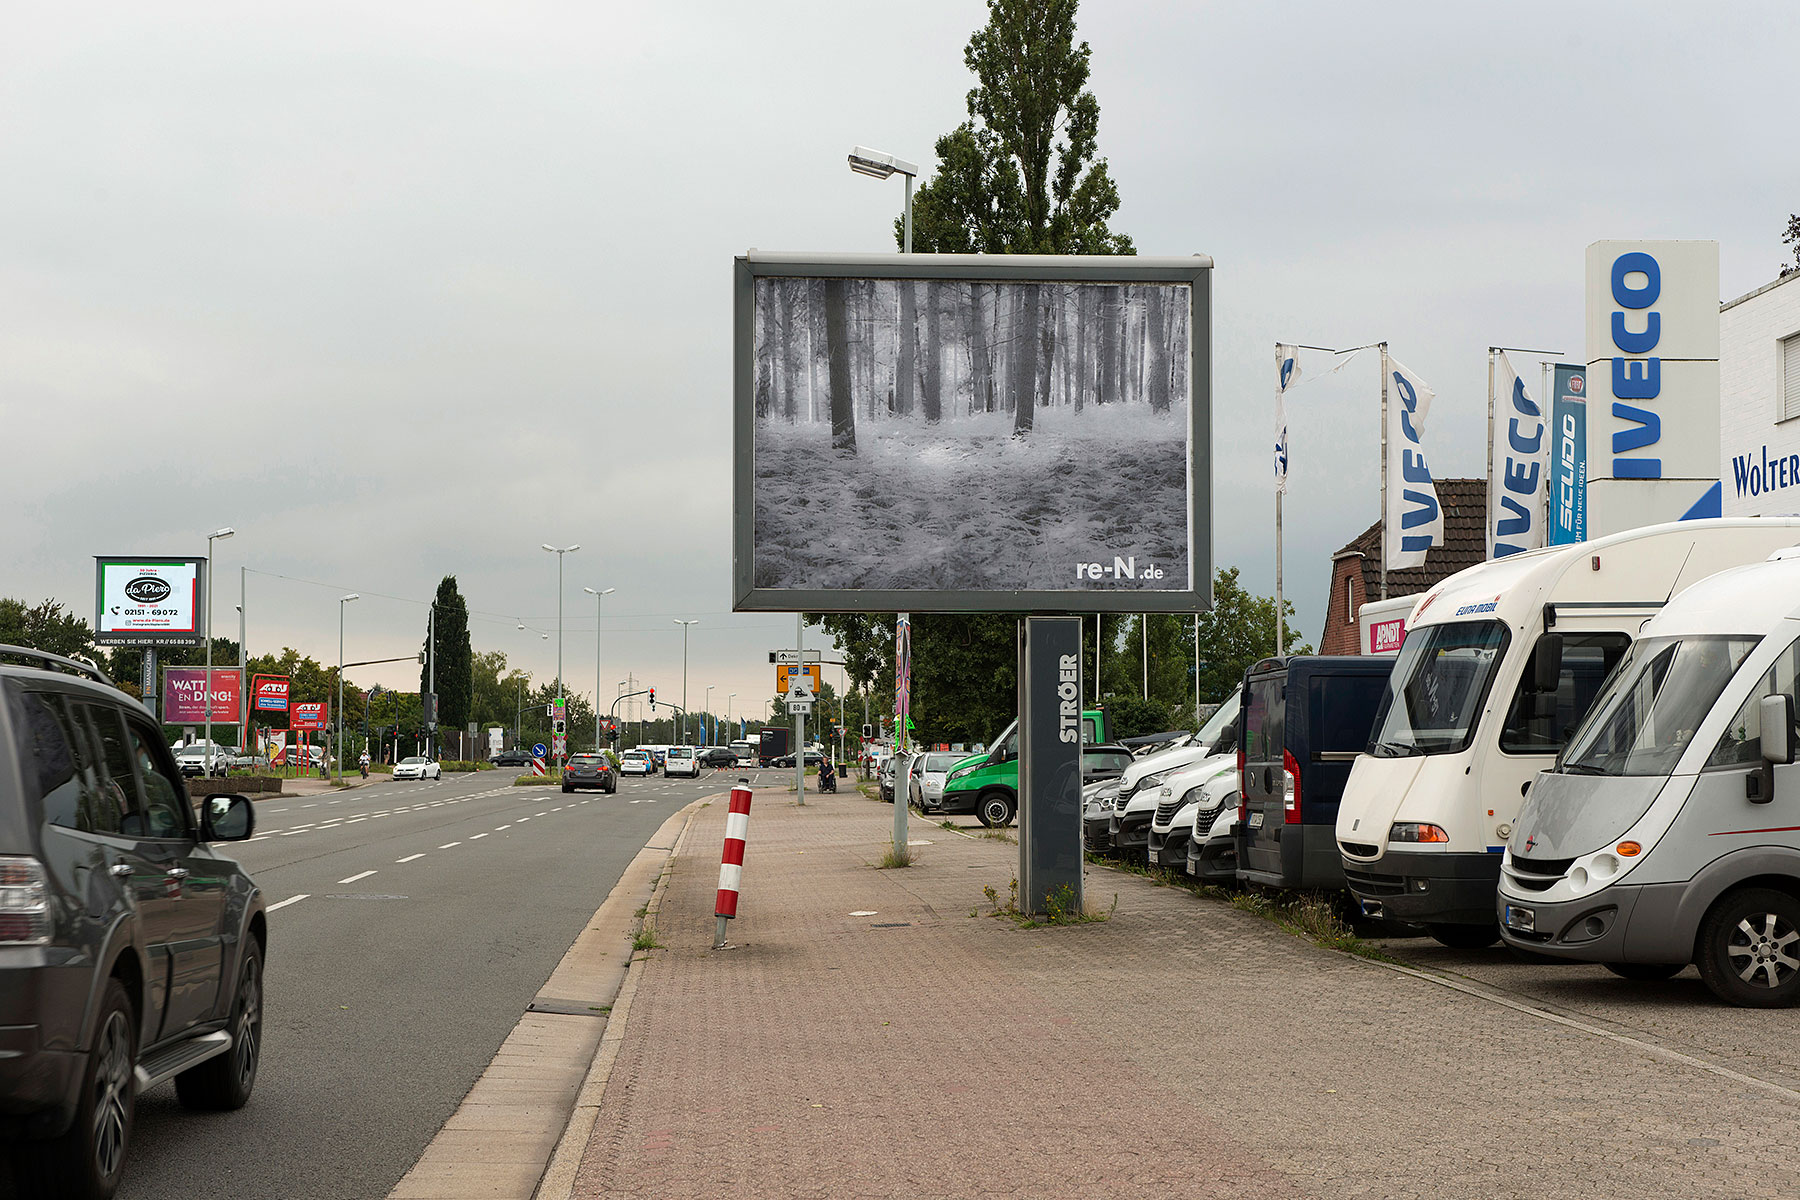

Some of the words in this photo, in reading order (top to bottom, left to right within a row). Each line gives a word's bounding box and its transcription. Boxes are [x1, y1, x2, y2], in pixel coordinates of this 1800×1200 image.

[1610, 251, 1661, 480] IVECO
[1559, 413, 1576, 533] SCUDO
[1575, 512, 1583, 530] FÜR
[126, 584, 141, 594] da
[142, 583, 170, 594] Piero
[1474, 602, 1498, 614] MOBIL
[172, 680, 206, 690] WATT
[194, 691, 232, 702] DING!
[1057, 653, 1078, 744] STRÖER
